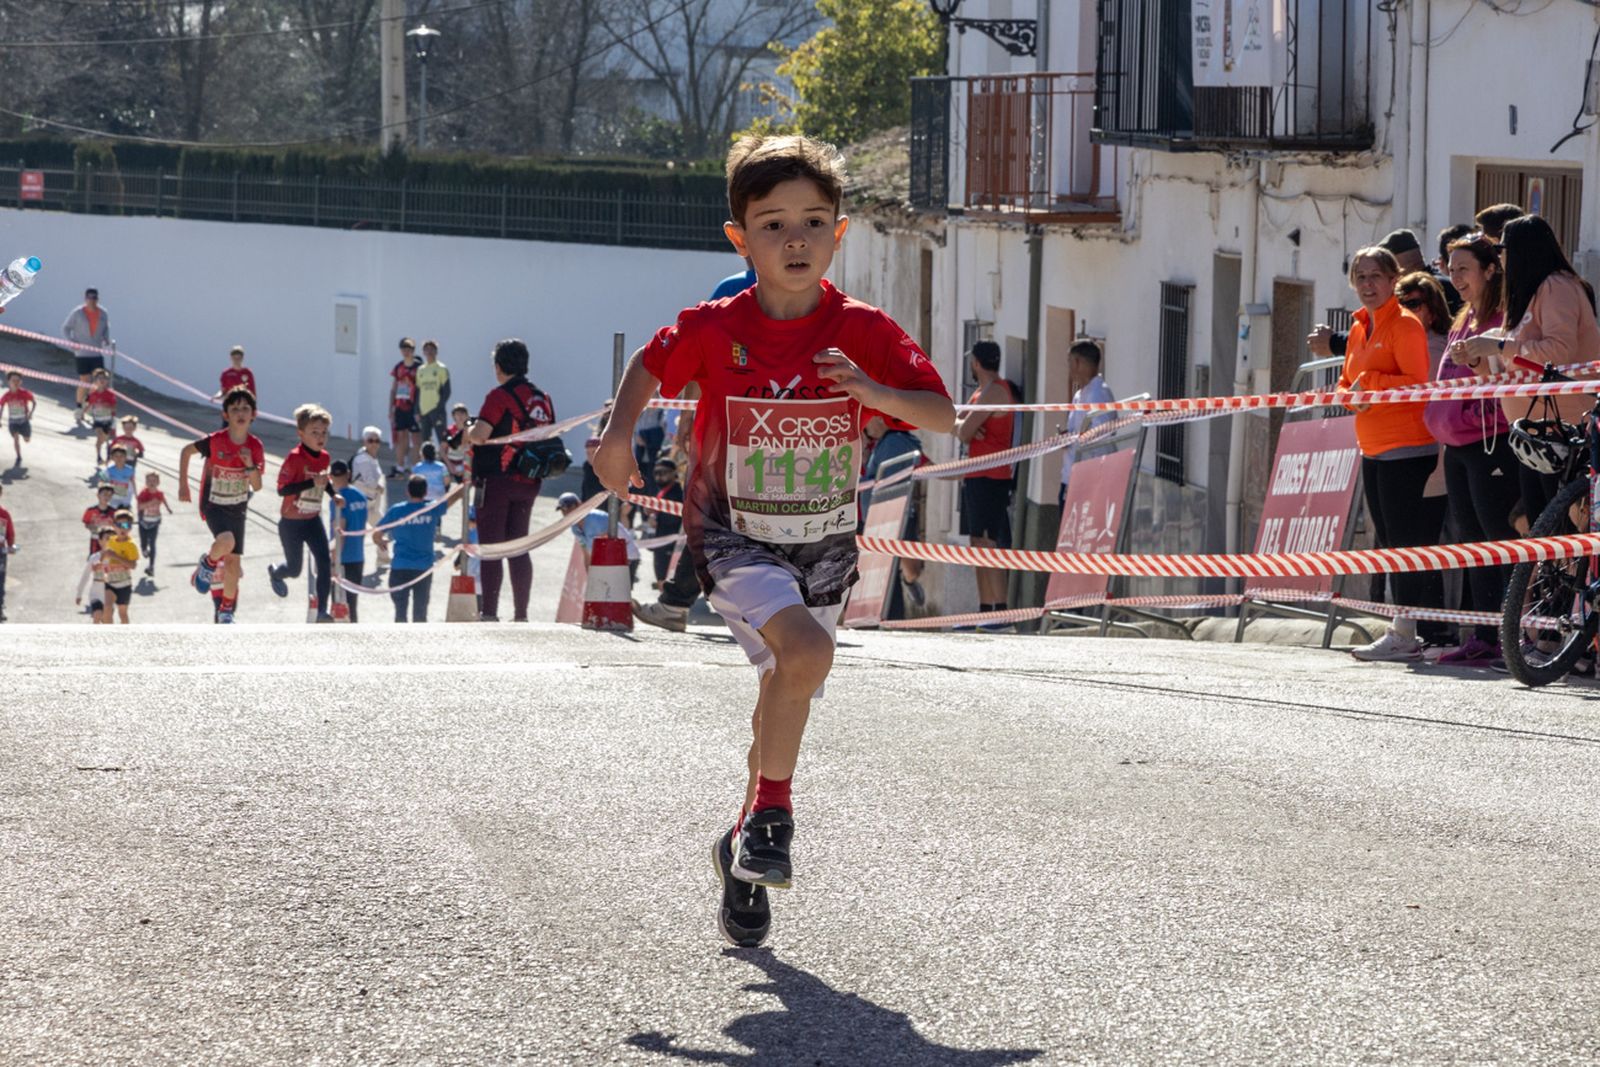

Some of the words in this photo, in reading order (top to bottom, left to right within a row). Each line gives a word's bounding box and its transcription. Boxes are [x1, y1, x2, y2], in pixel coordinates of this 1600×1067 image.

[749, 407, 774, 435] X
[779, 413, 851, 436] CROSS
[748, 435, 838, 452] PANTANO
[744, 445, 852, 494] 1143
[1272, 453, 1311, 496] CROSS
[1303, 447, 1358, 494] PANTANO
[736, 499, 778, 513] MARTIN
[1258, 518, 1284, 554] DEL
